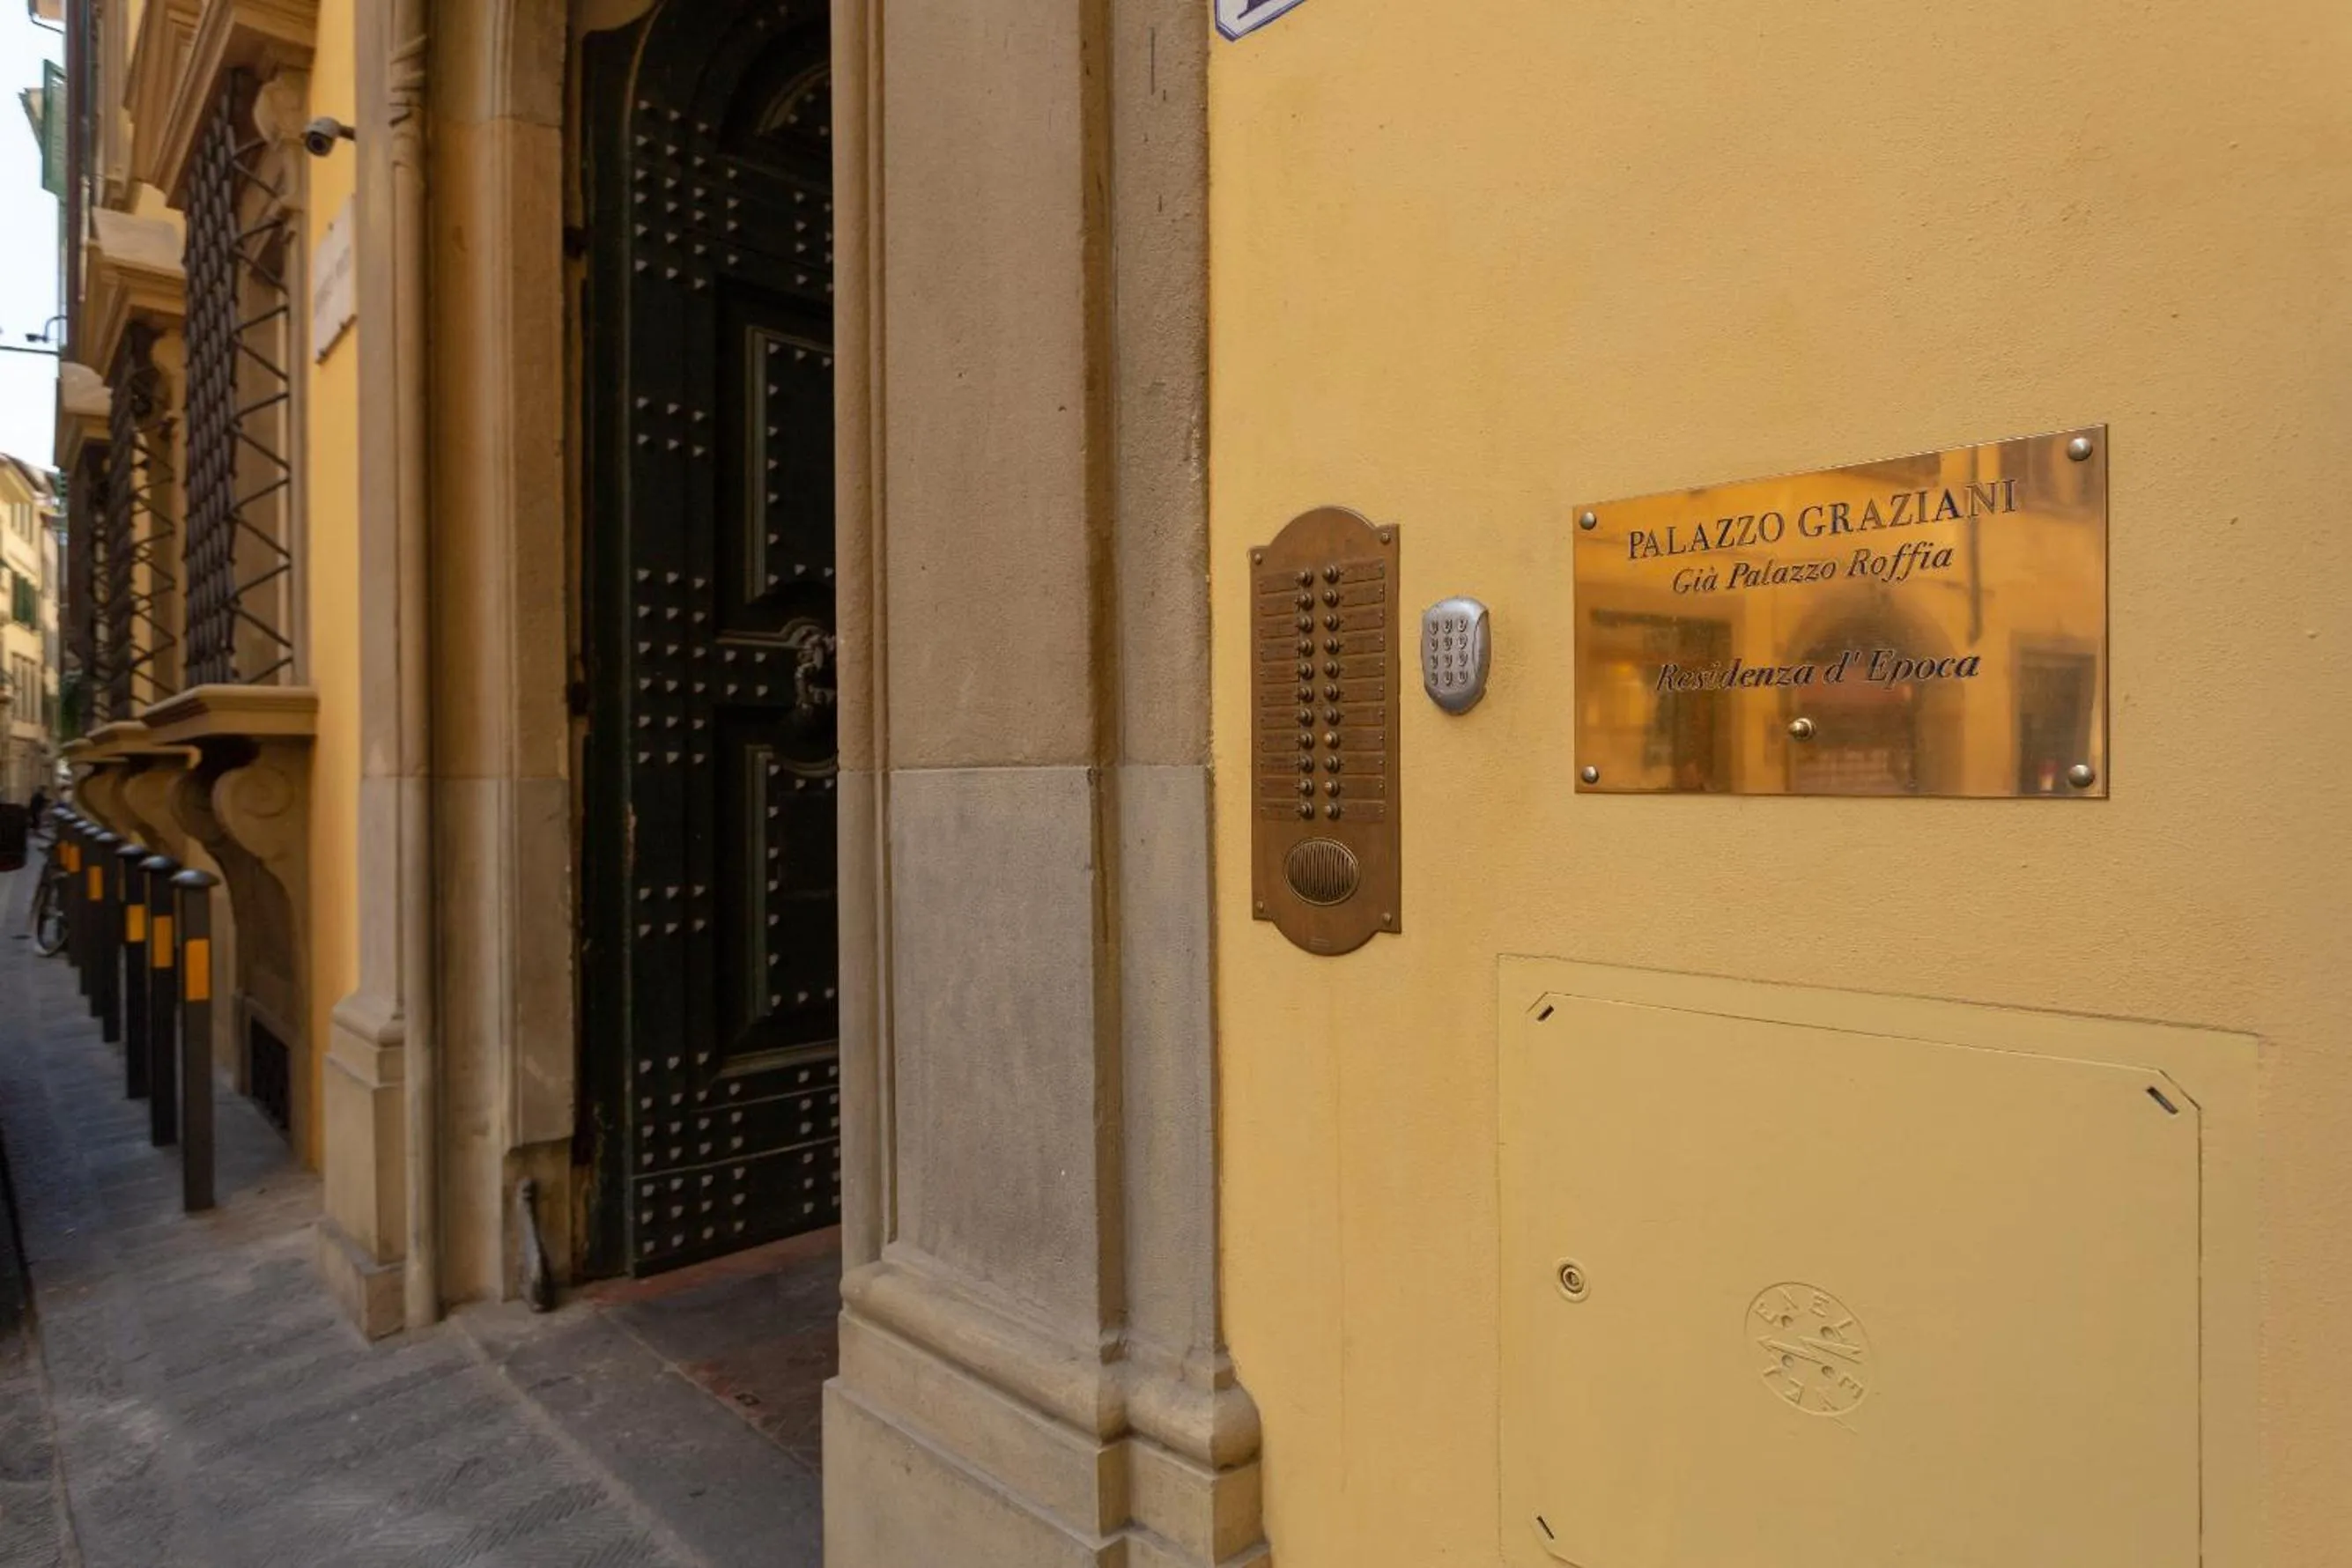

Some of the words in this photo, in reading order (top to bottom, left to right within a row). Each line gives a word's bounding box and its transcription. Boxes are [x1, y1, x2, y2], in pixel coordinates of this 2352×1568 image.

[1629, 512, 1785, 559] PALAZZO
[1797, 479, 2016, 537] GRAZIANI
[1672, 566, 1718, 595] Già
[1727, 558, 1837, 588] Palazzo
[1847, 540, 1955, 582] Roffia
[1655, 658, 1815, 691] Residenza
